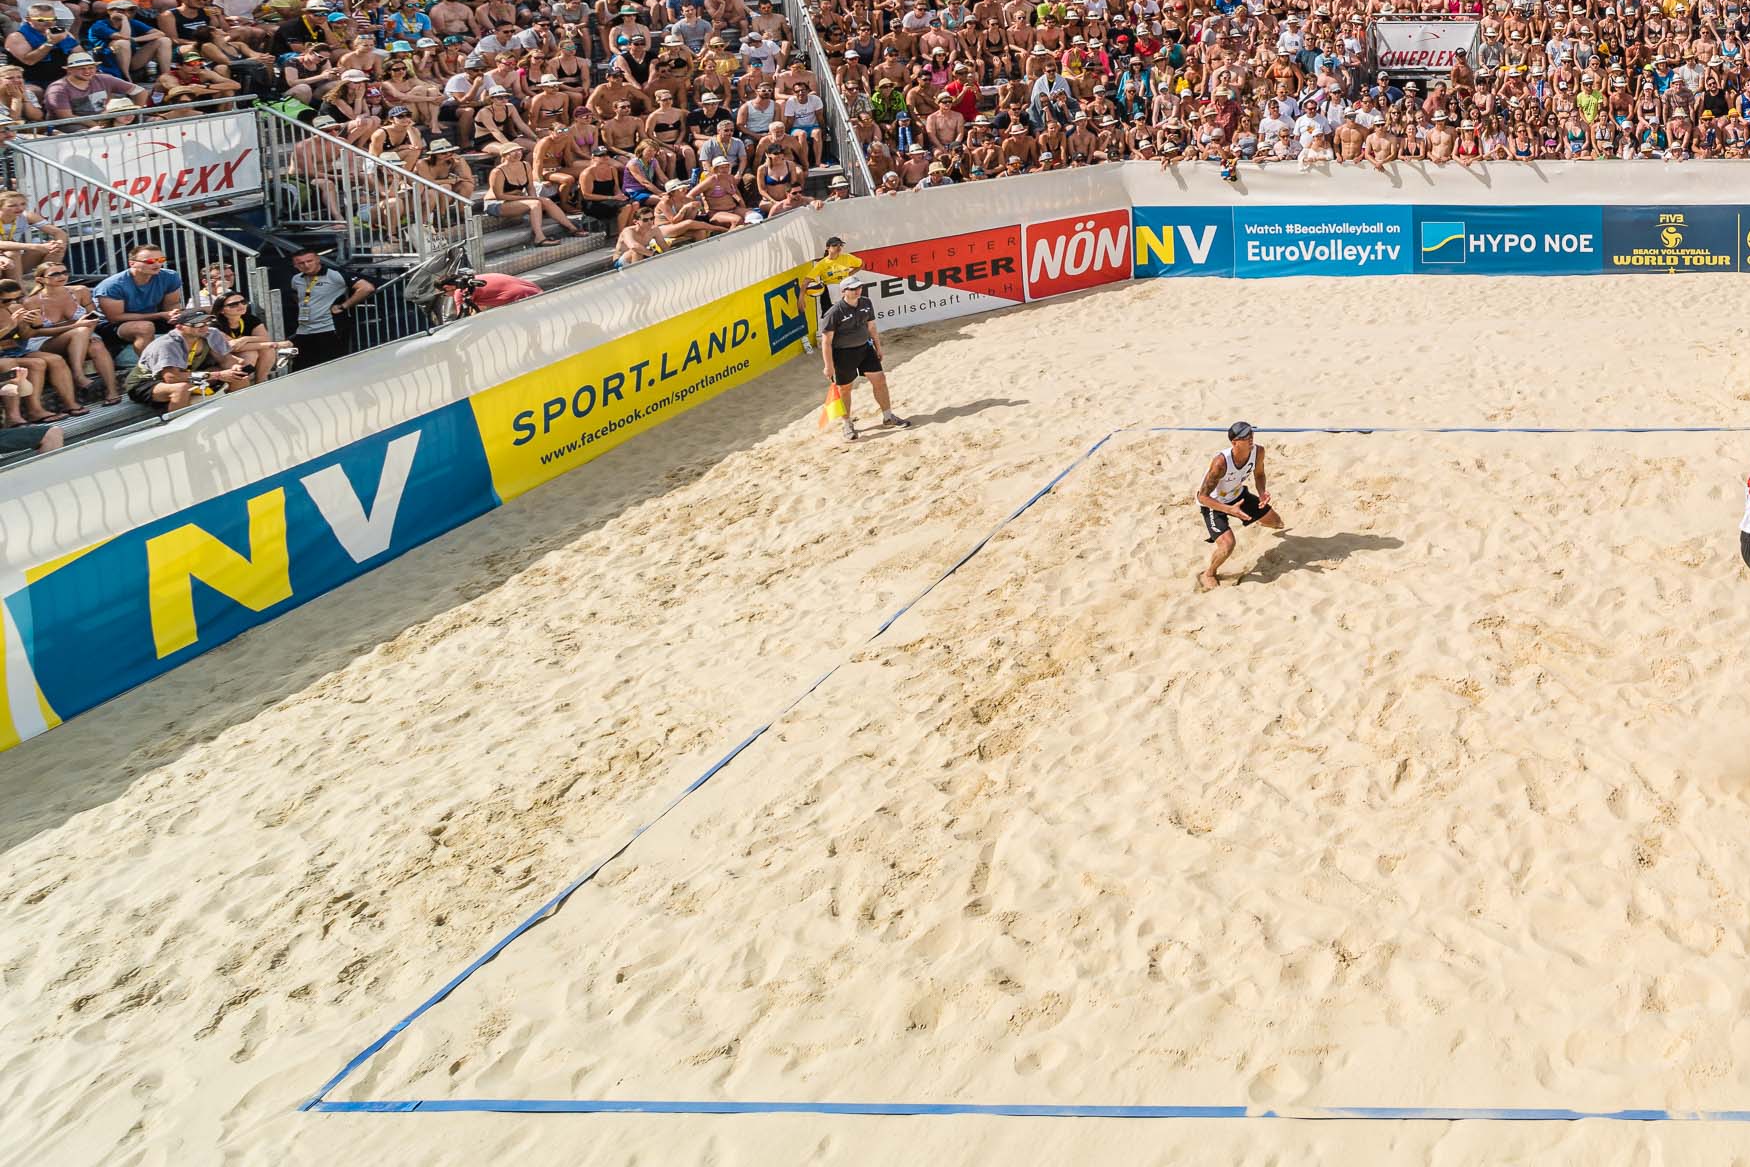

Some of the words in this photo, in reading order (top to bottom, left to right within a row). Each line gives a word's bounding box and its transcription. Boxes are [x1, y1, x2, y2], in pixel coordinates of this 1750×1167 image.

[38, 149, 253, 221] CINEPLEXX
[1245, 224, 1282, 234] Watch
[1285, 223, 1384, 235] #BeachVolleyball
[1387, 225, 1400, 233] on
[1660, 214, 1684, 223] FIVB
[863, 237, 1016, 271] UMEISTER
[1030, 220, 1128, 284] NÖN
[1136, 225, 1217, 265] NV
[1247, 240, 1400, 265] EuroVolley.tv
[1469, 234, 1536, 253] HYPO
[1544, 234, 1593, 253] NOE
[1613, 256, 1678, 266] WORLD
[1683, 256, 1731, 266] TOUR
[861, 256, 1016, 300] TEURER
[877, 294, 961, 320] sellschaft
[512, 318, 757, 446] SPORT.LAND.
[540, 359, 750, 465] www.facebook.com/sportlandnoe
[146, 430, 420, 659] NV
